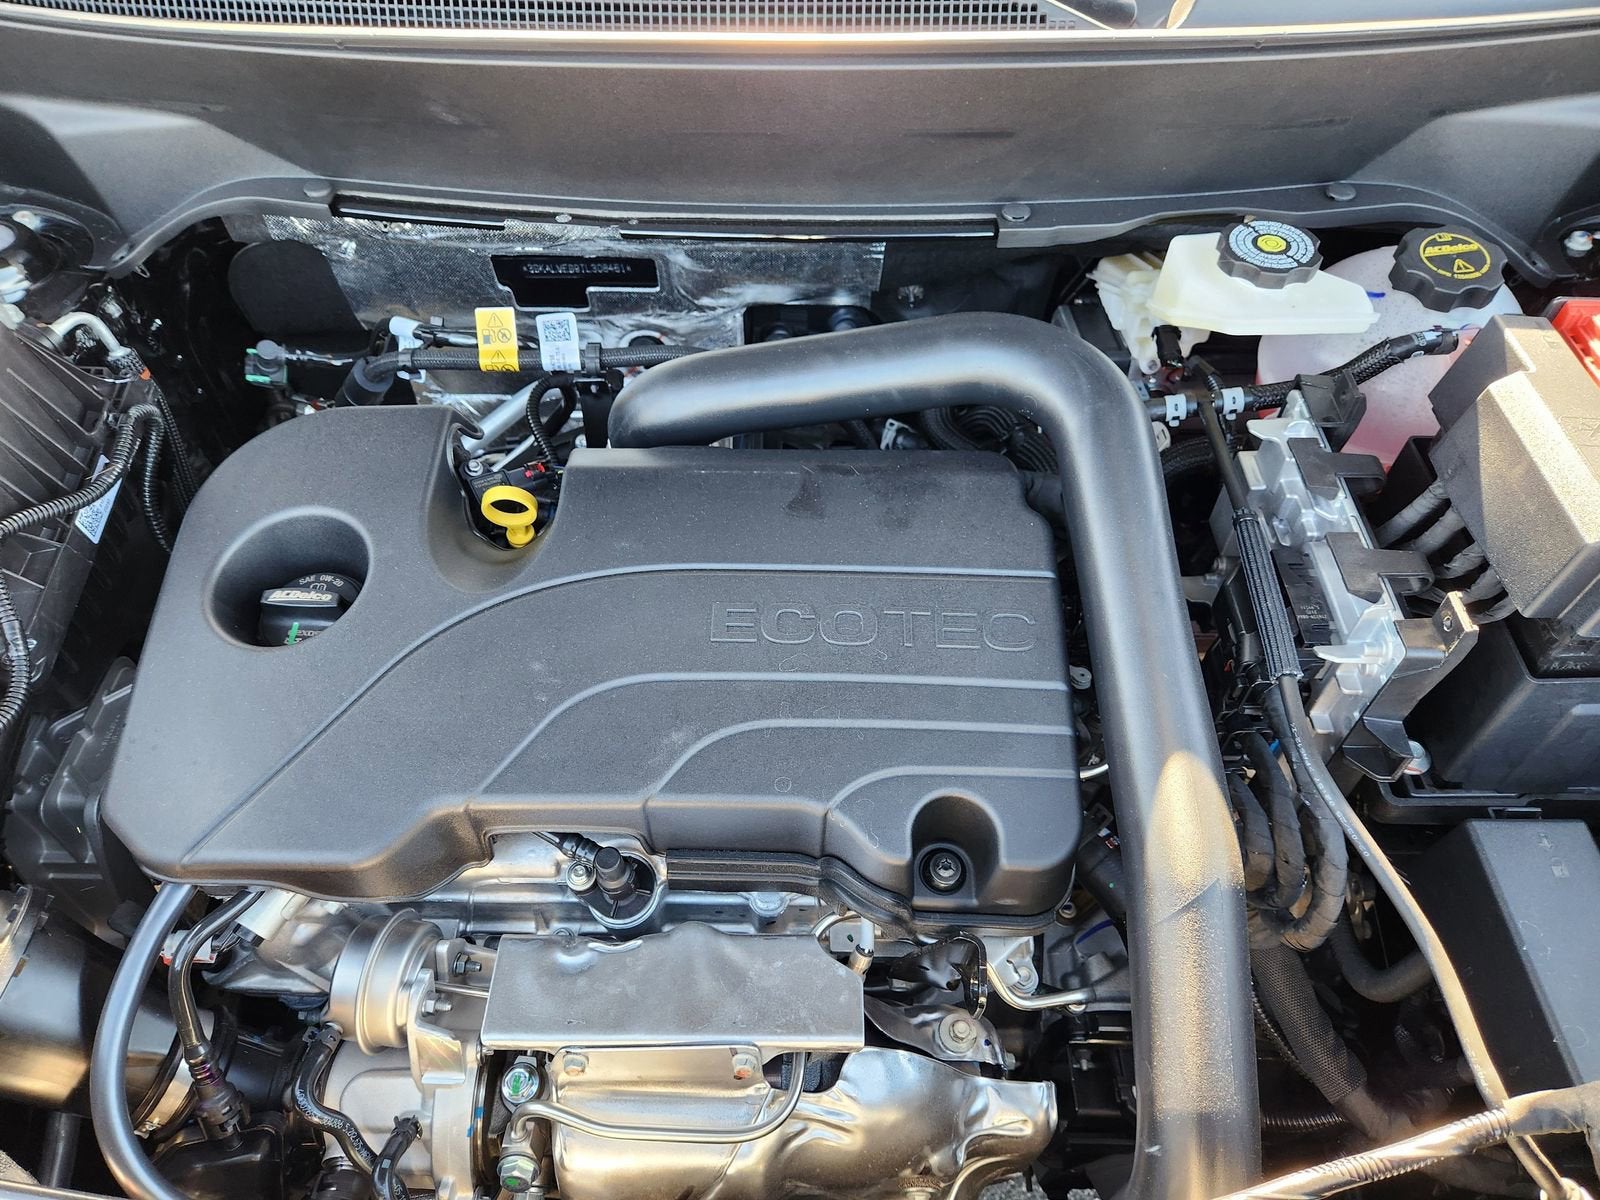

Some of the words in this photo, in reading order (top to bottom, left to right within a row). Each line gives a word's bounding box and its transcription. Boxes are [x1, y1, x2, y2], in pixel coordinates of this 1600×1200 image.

[1424, 244, 1479, 257] ACDelco
[299, 575, 316, 585] SAE
[319, 575, 344, 587] 0W-20
[267, 590, 332, 601] ACDelco
[710, 600, 1037, 651] ECOTEC
